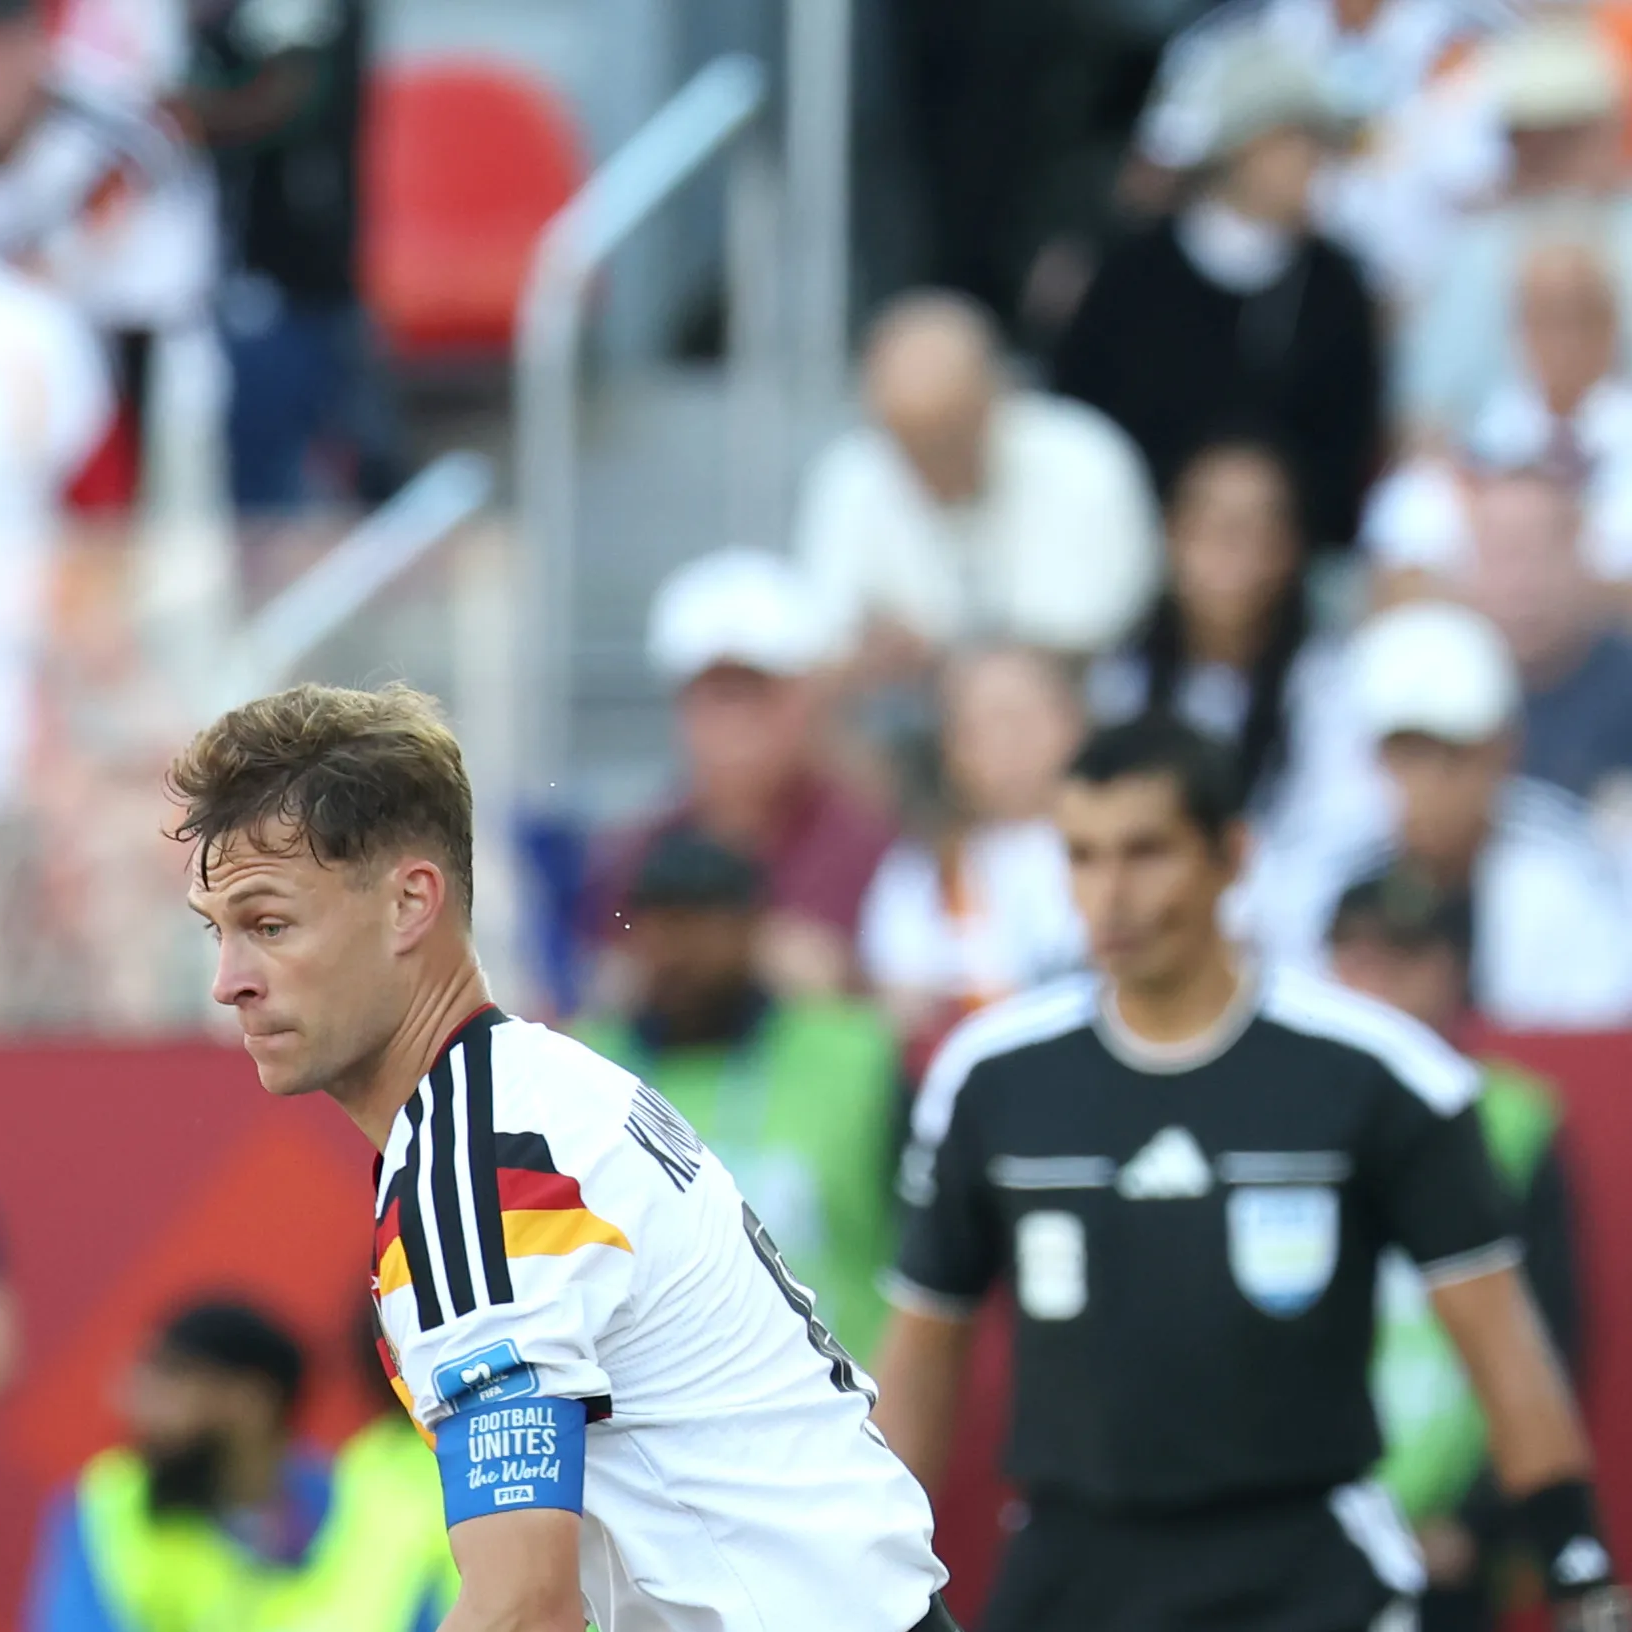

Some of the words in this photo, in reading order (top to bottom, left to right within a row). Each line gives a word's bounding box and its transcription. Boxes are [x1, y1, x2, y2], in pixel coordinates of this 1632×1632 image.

[479, 1385, 504, 1402] FIFA
[469, 1406, 557, 1436] FOOTBALL
[468, 1428, 557, 1463] UNITES
[466, 1463, 499, 1490] the
[501, 1457, 561, 1483] World
[498, 1488, 531, 1502] FIFA
